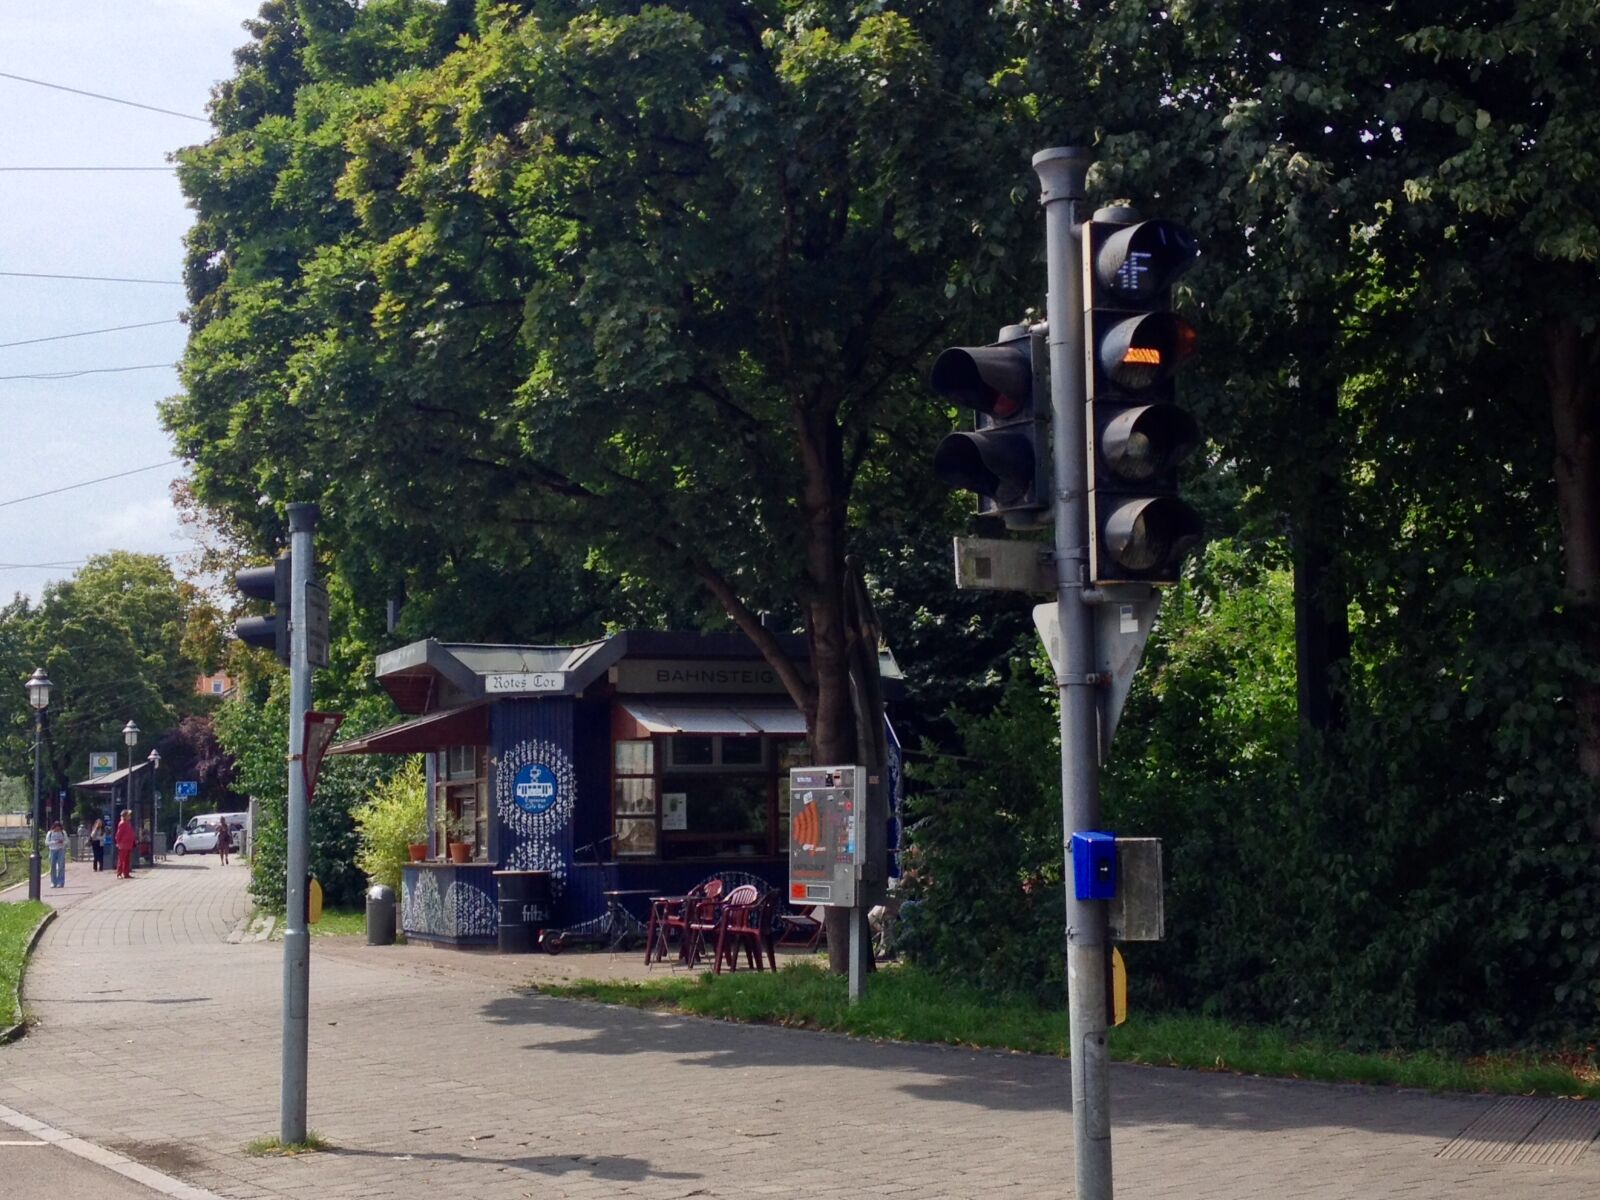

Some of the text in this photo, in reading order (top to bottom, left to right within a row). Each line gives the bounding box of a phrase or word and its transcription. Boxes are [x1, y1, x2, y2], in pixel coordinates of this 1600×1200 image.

[493, 674, 556, 689] Rotes Tor
[656, 669, 774, 684] BAHNSTEIG
